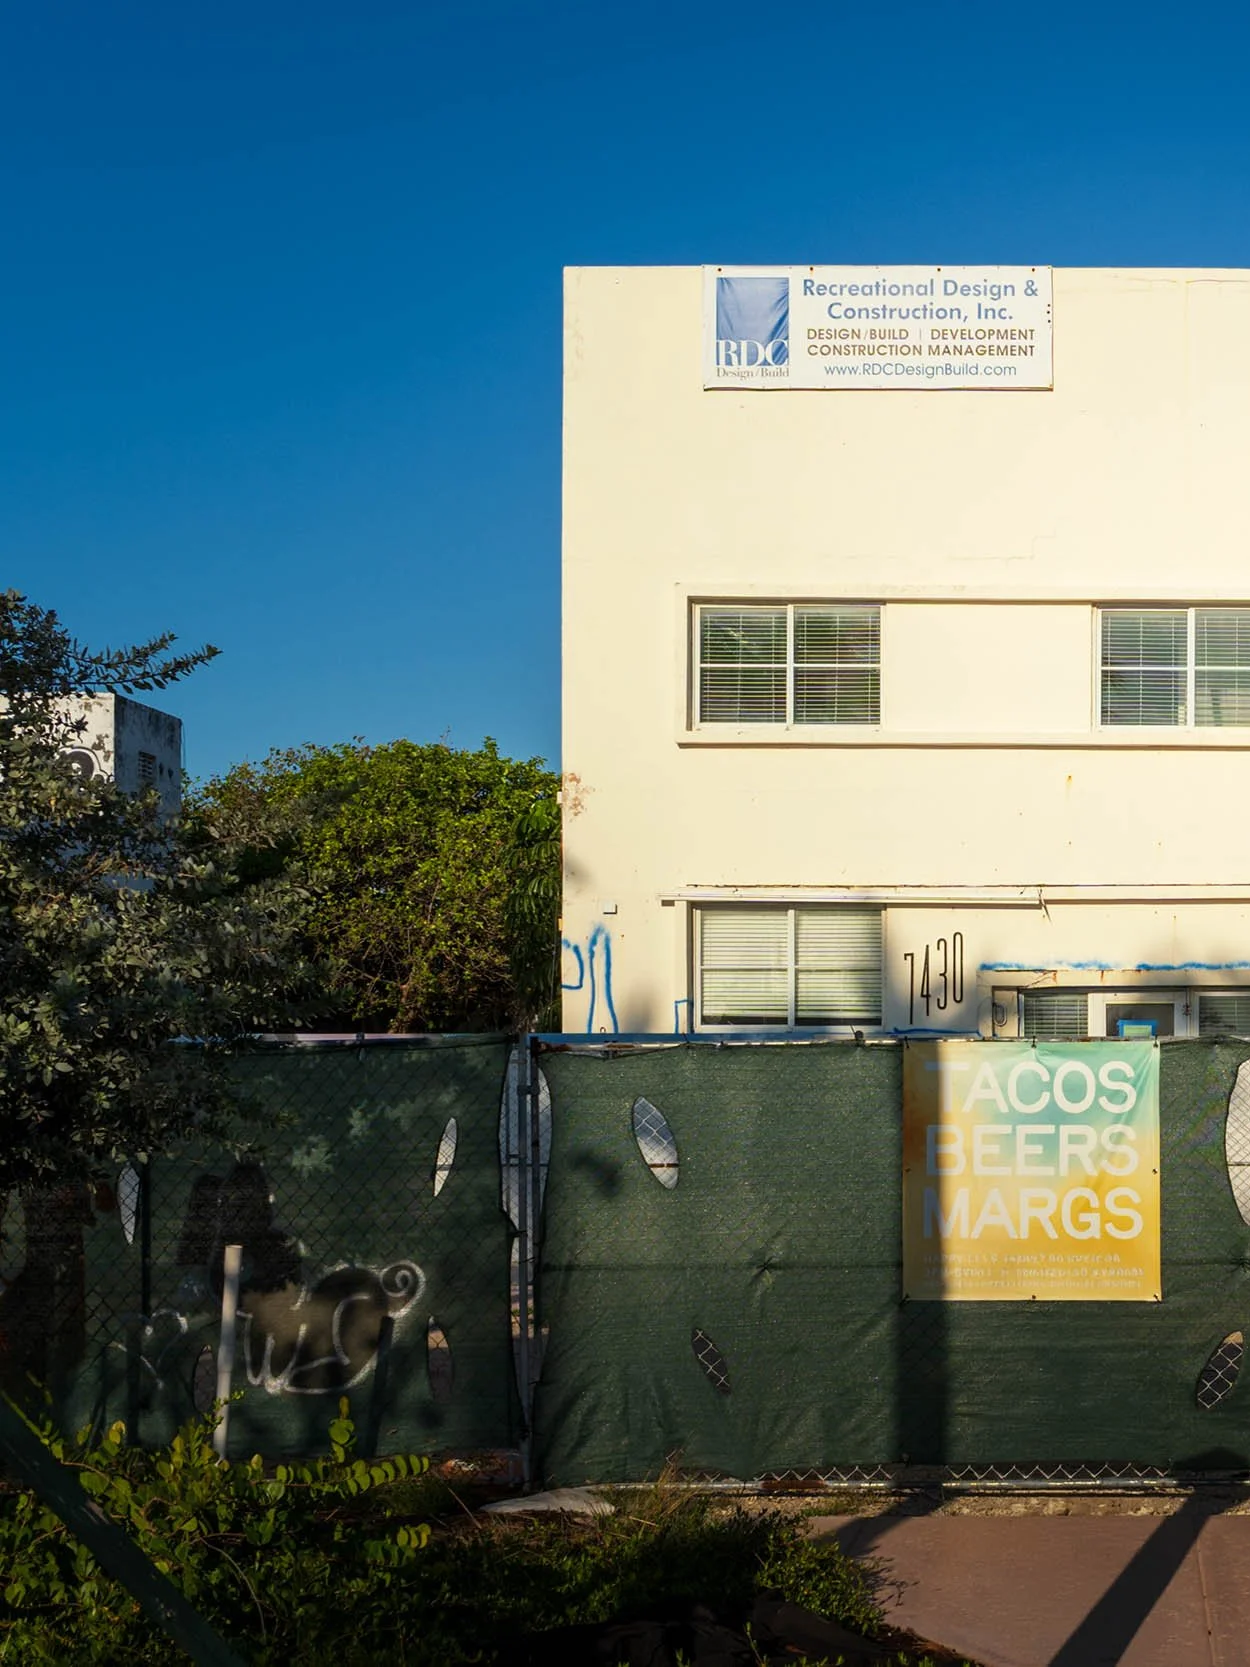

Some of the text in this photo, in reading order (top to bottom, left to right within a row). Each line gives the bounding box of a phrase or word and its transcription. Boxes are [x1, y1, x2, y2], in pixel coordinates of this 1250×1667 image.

[803, 278, 1039, 301] Recreational Design &
[827, 302, 1013, 323] Construction, Inc.
[930, 328, 1035, 341] DEVELOPMENT
[716, 339, 789, 367] RDC
[807, 344, 1035, 356] CONSTRUCTION MANAGEMENT
[716, 367, 790, 380] Design/Build
[824, 362, 1017, 379] www.RDCDesignBuild.com
[904, 932, 963, 1025] 7430
[923, 1060, 1137, 1114] TACOS
[925, 1124, 1140, 1177] BEERS
[922, 1187, 1144, 1241] MARGS
